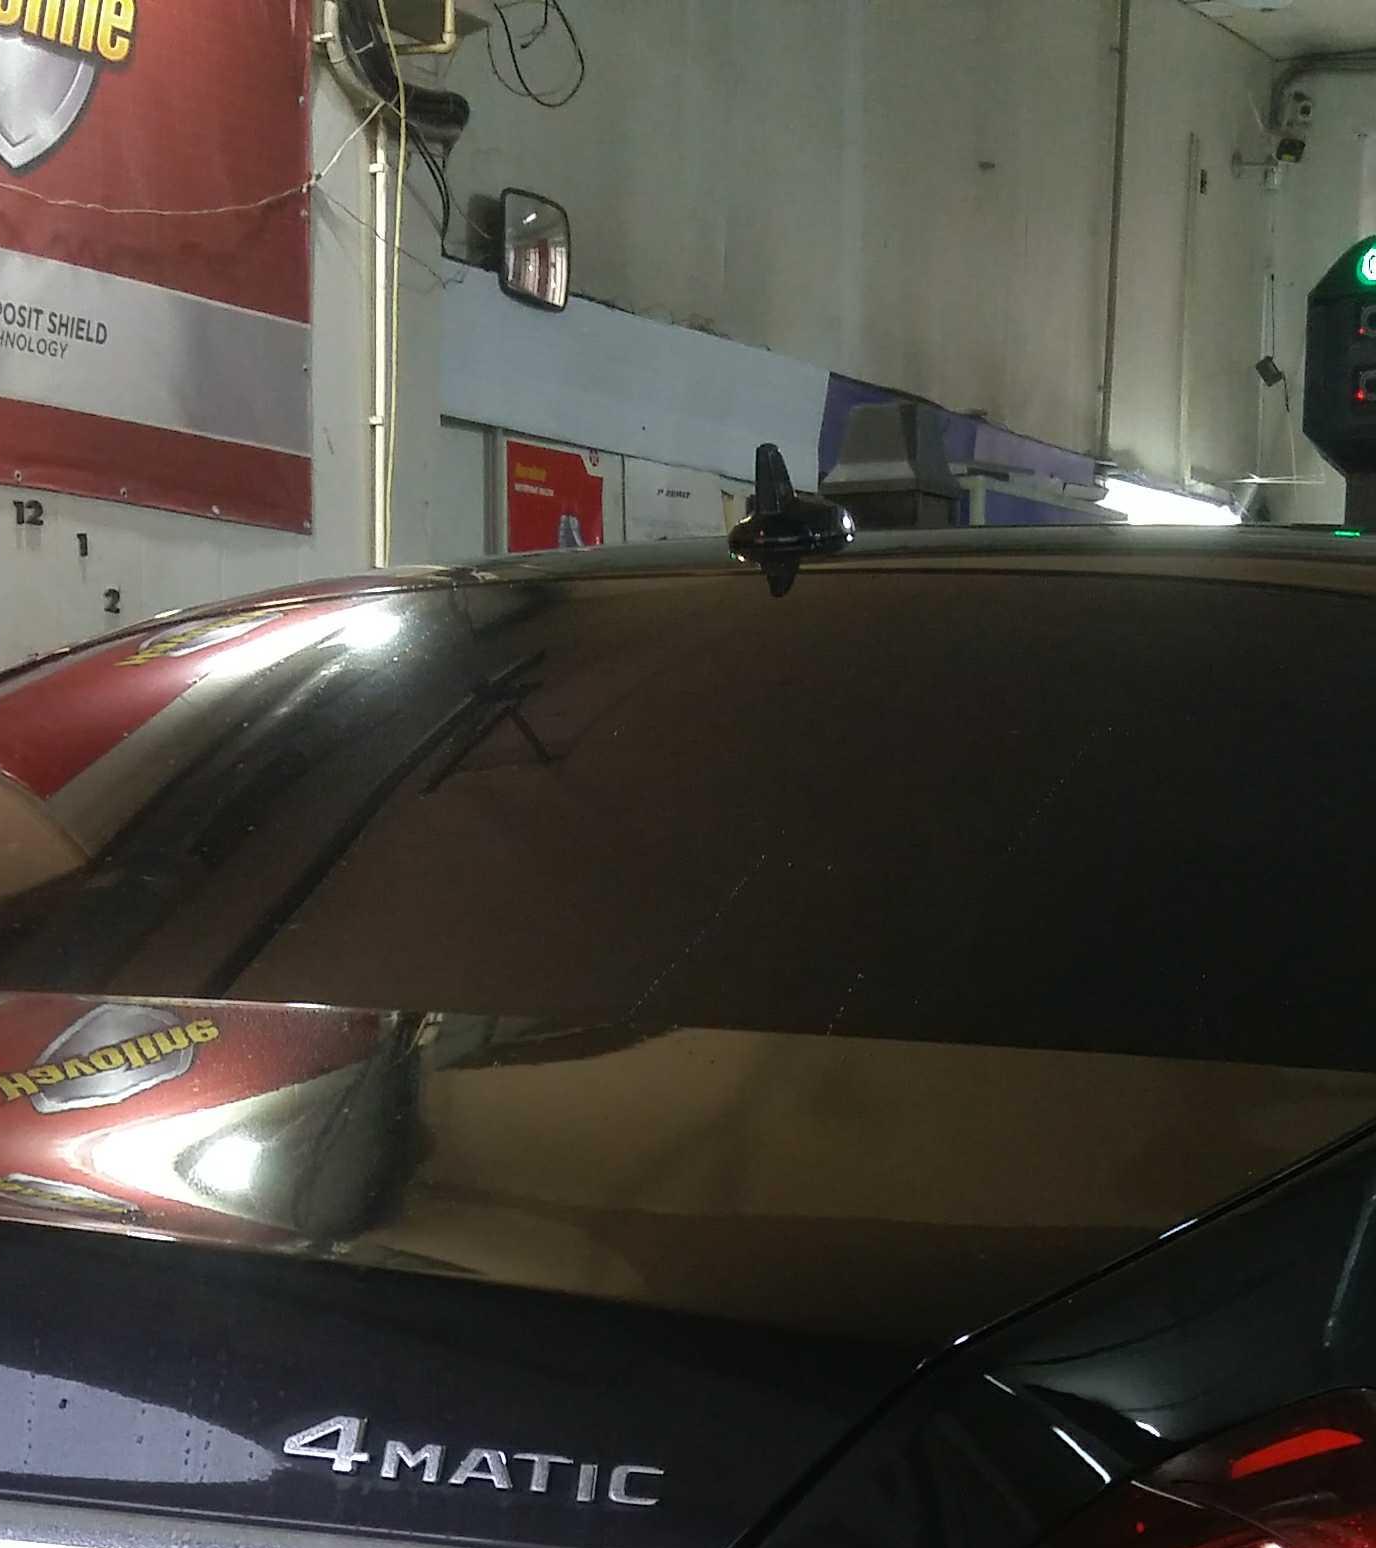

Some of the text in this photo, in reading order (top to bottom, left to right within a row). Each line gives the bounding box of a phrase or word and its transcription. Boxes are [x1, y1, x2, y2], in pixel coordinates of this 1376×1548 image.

[47, 311, 108, 345] SHIELD
[13, 499, 44, 526] 12
[76, 532, 89, 557] 1
[103, 588, 121, 614] 2
[283, 1414, 665, 1506] 4MATIC
